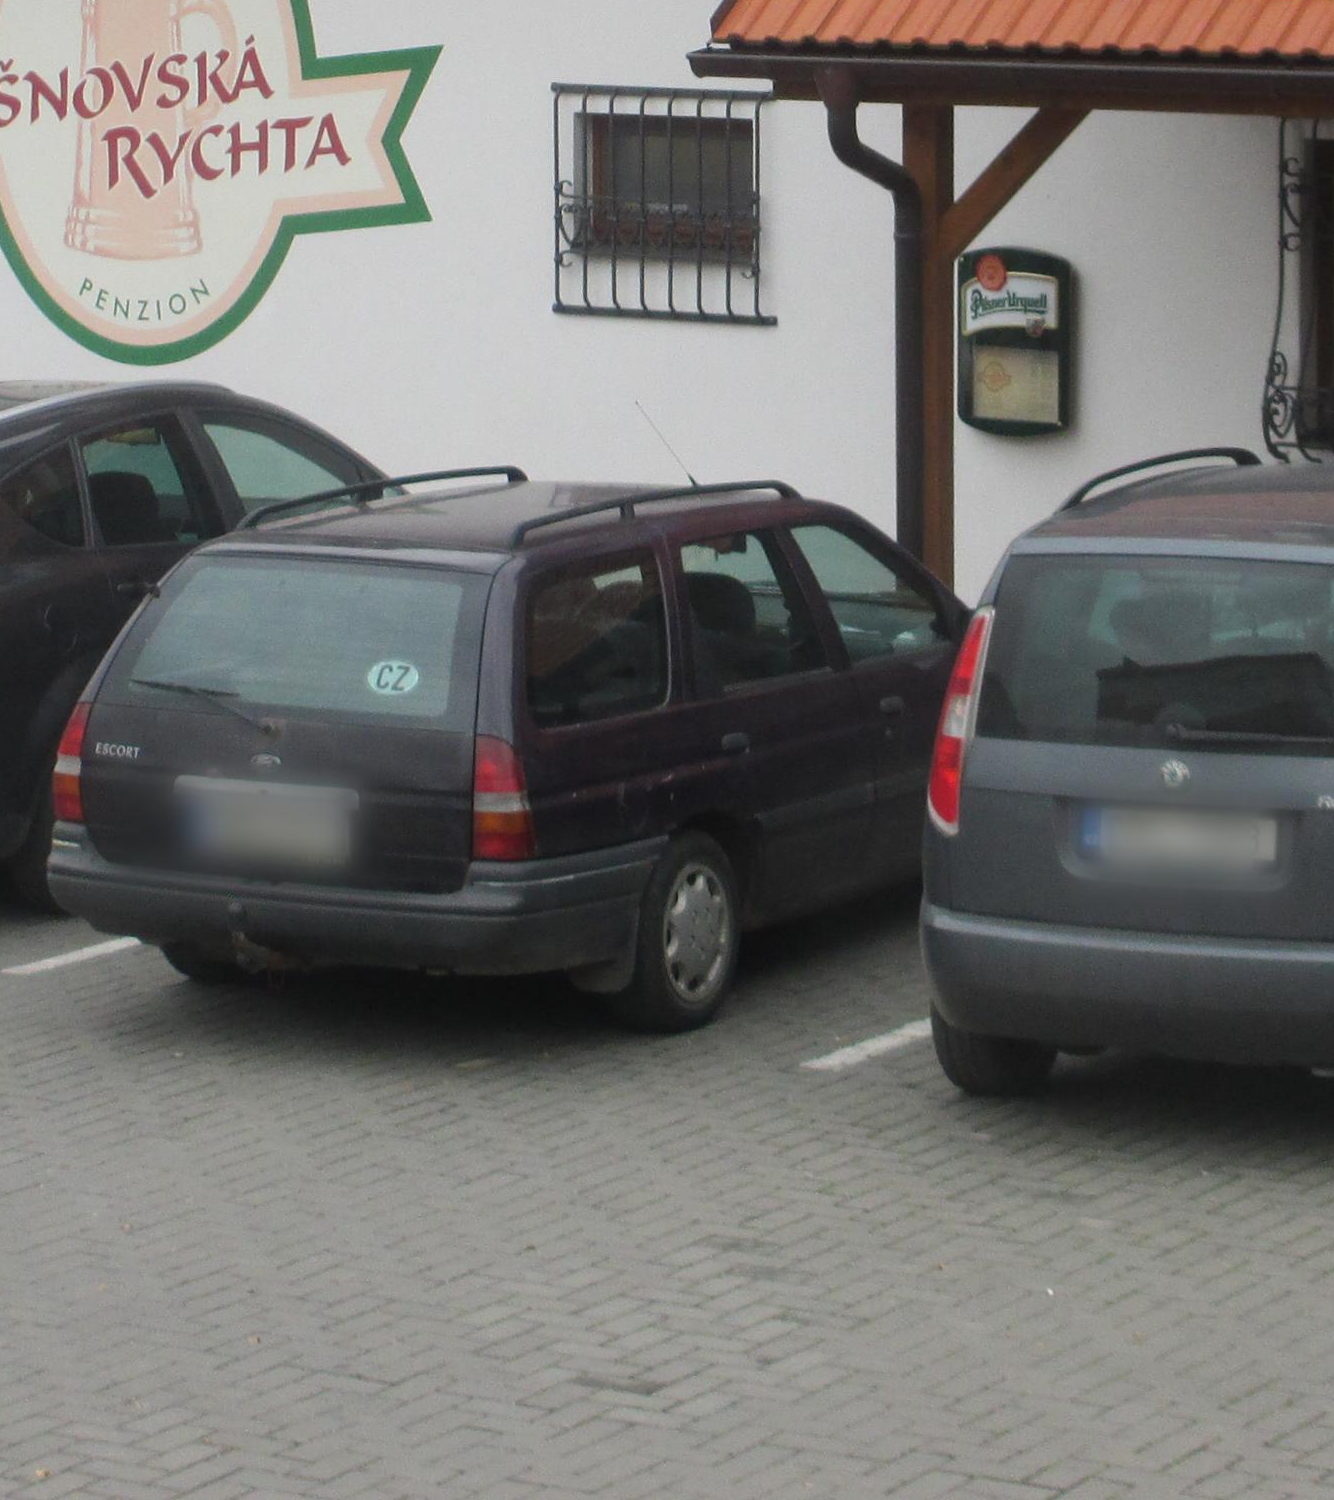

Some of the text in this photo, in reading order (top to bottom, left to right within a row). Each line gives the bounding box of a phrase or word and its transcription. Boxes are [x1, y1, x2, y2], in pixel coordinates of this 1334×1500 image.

[101, 112, 352, 201] RYCHTA
[78, 277, 211, 322] PENZION
[970, 289, 1047, 320] Pilsner Urquell
[377, 664, 410, 691] CZ
[95, 742, 140, 759] ESCORT
